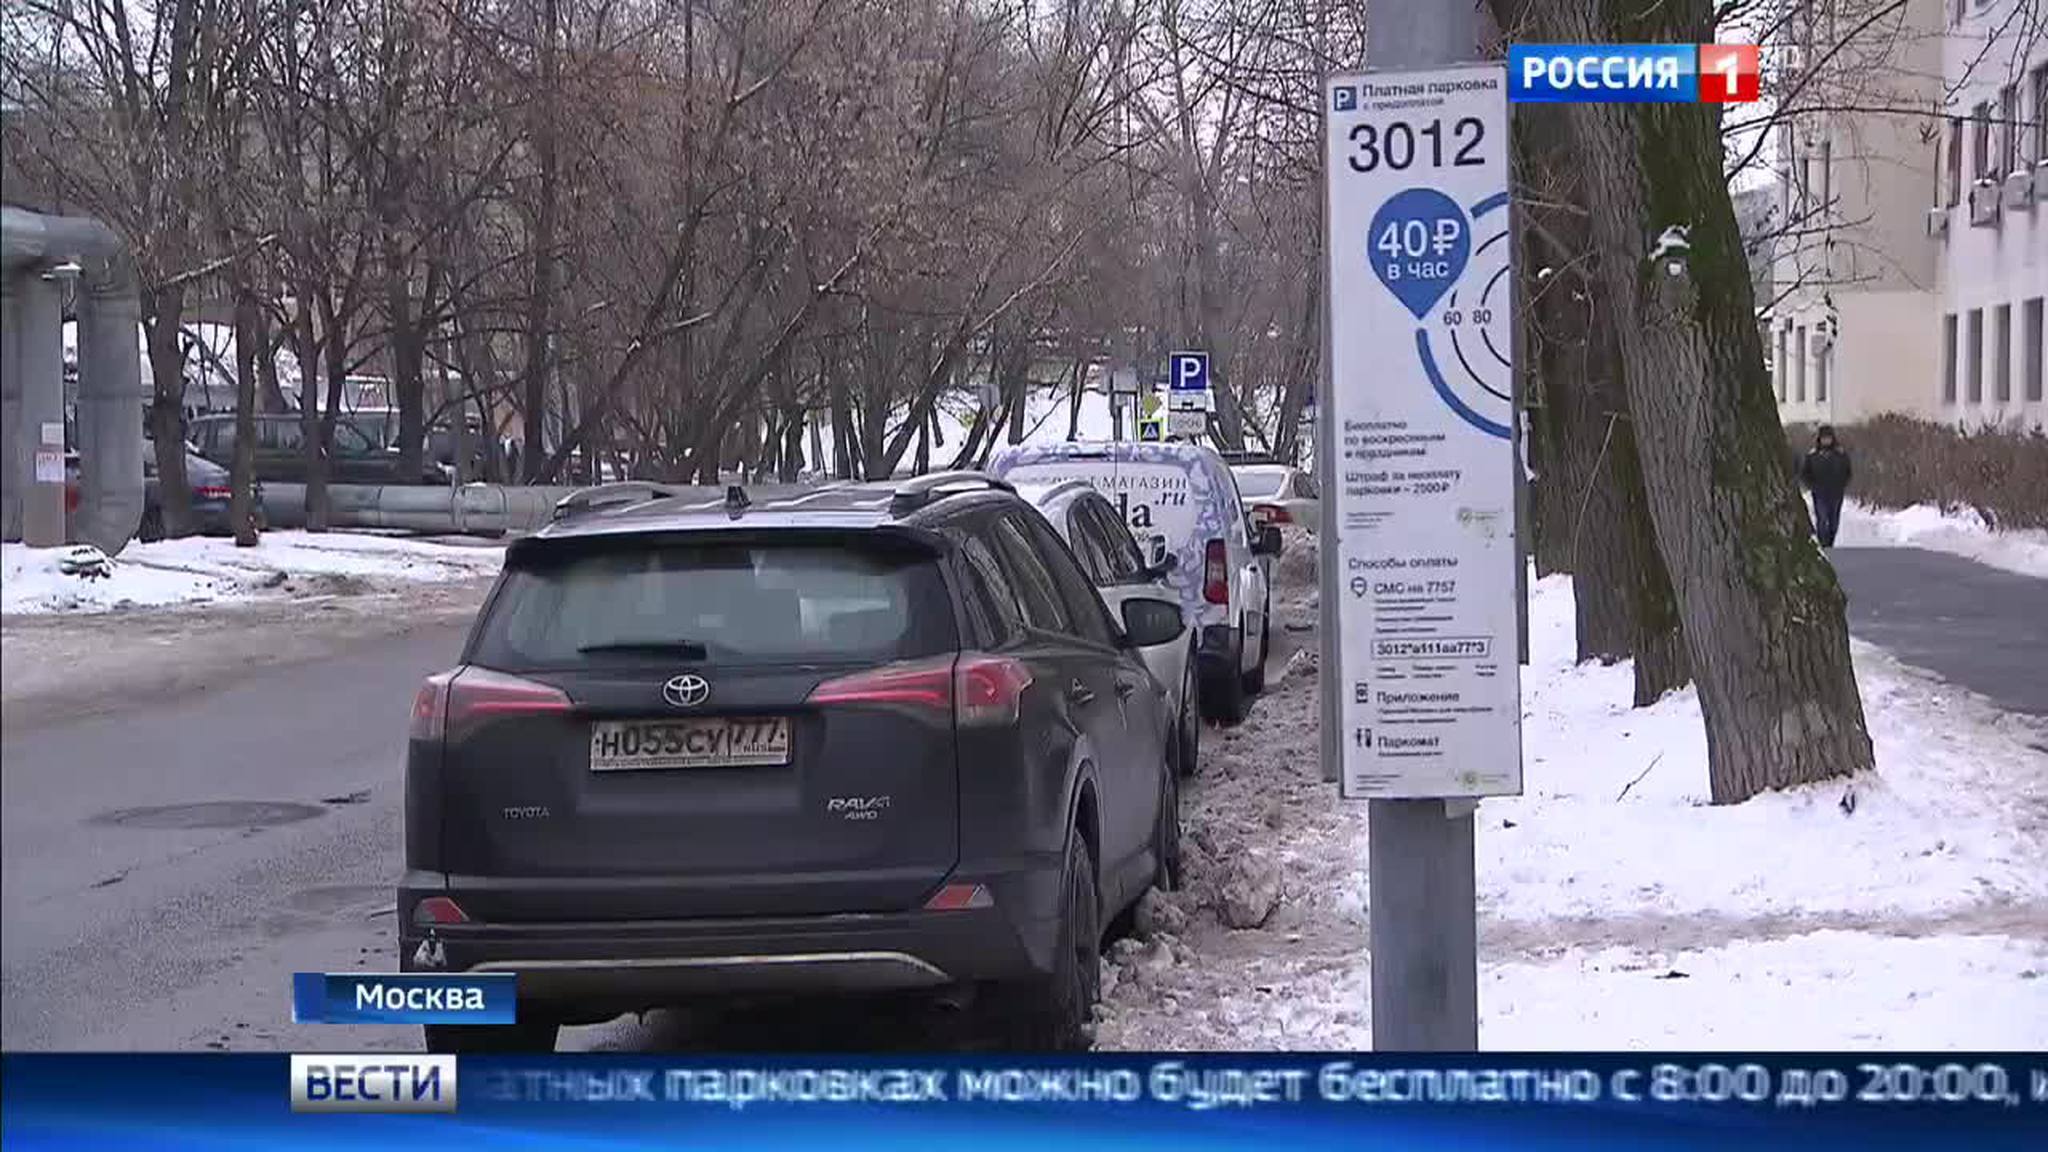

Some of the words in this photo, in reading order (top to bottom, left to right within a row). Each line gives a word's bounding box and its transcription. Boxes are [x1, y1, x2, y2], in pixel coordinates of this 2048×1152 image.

[1362, 83, 1425, 98] Платная
[1428, 78, 1498, 95] парковка
[1348, 117, 1486, 173] 3012
[1387, 264, 1401, 280] в
[1407, 260, 1449, 279] час
[1443, 310, 1462, 326] 60
[1472, 309, 1492, 325] 80
[1180, 357, 1201, 388] P
[1103, 476, 1187, 489] МАГАЗИН
[1345, 470, 1389, 483] Штраф
[1348, 557, 1406, 571] Способы
[1409, 557, 1458, 569] оплаты
[1374, 582, 1405, 595] СМС
[1407, 584, 1423, 594] на
[1426, 581, 1456, 594] 7757
[1377, 691, 1460, 705] Приложение
[1377, 736, 1440, 750] Паркомат
[503, 807, 551, 820] TOYOTA
